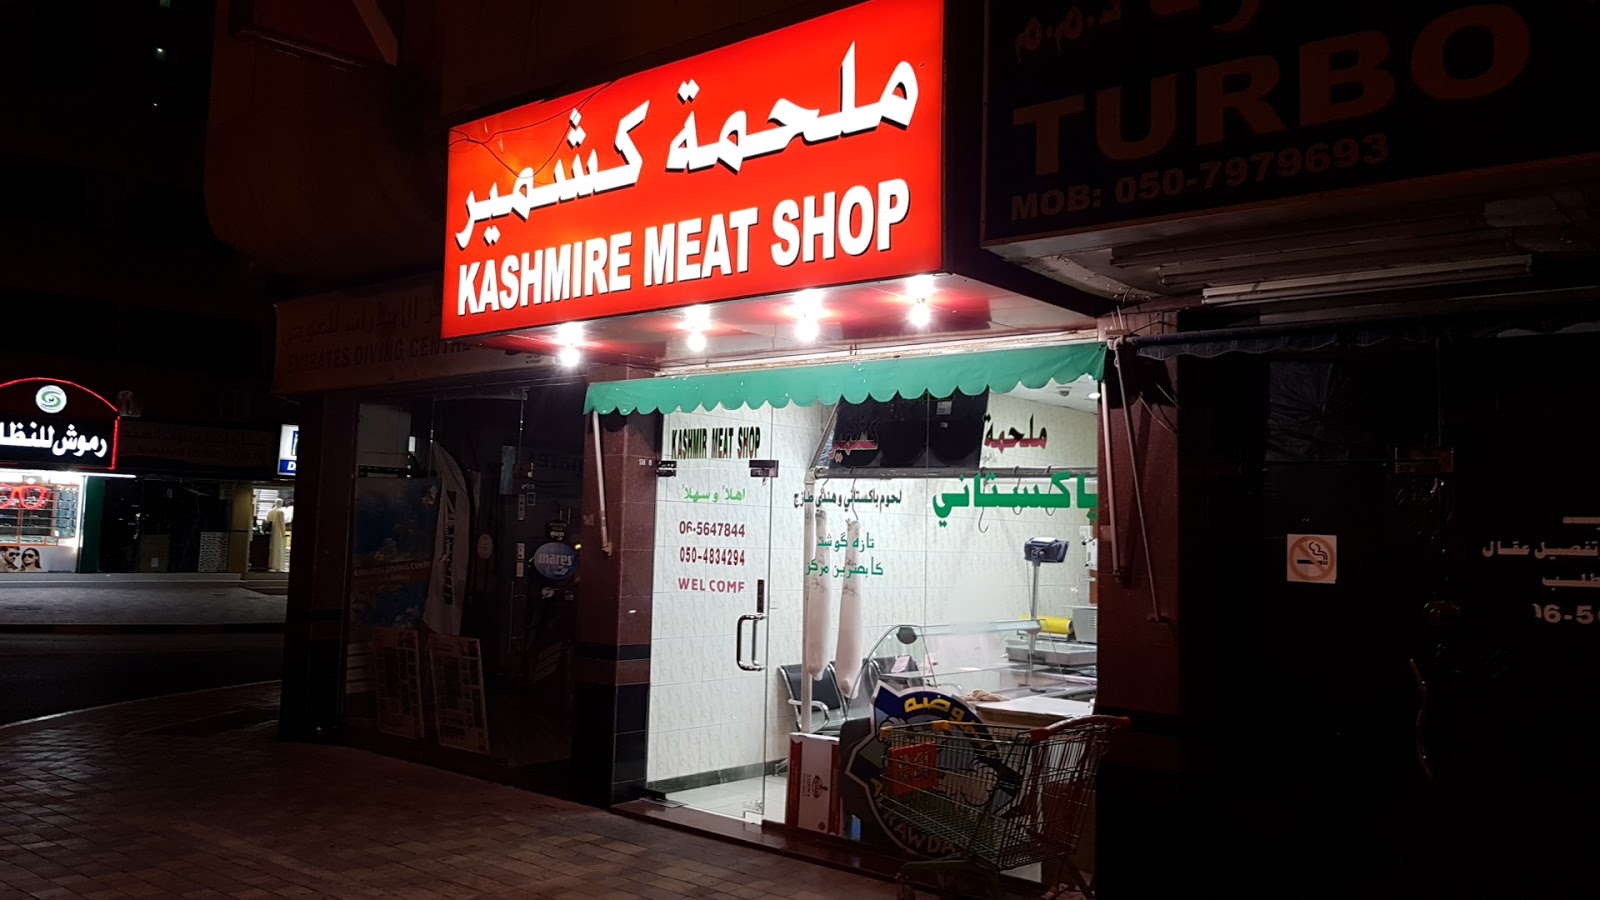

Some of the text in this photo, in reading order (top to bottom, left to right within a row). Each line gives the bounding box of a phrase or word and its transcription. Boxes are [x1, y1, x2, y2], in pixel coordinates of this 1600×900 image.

[1012, 3, 1533, 177] TURBO
[456, 41, 919, 249] ملحمة كشمير
[1010, 131, 1391, 222] MOB: 050-7979693
[457, 178, 911, 316] KASHMIRE MEAT SHOP
[52, 424, 107, 458] رموش
[671, 426, 761, 459] KASHMIR MEAT SHOP
[679, 520, 746, 538] 06-5647844
[538, 553, 575, 567] mares
[679, 547, 745, 566] 050-4834294
